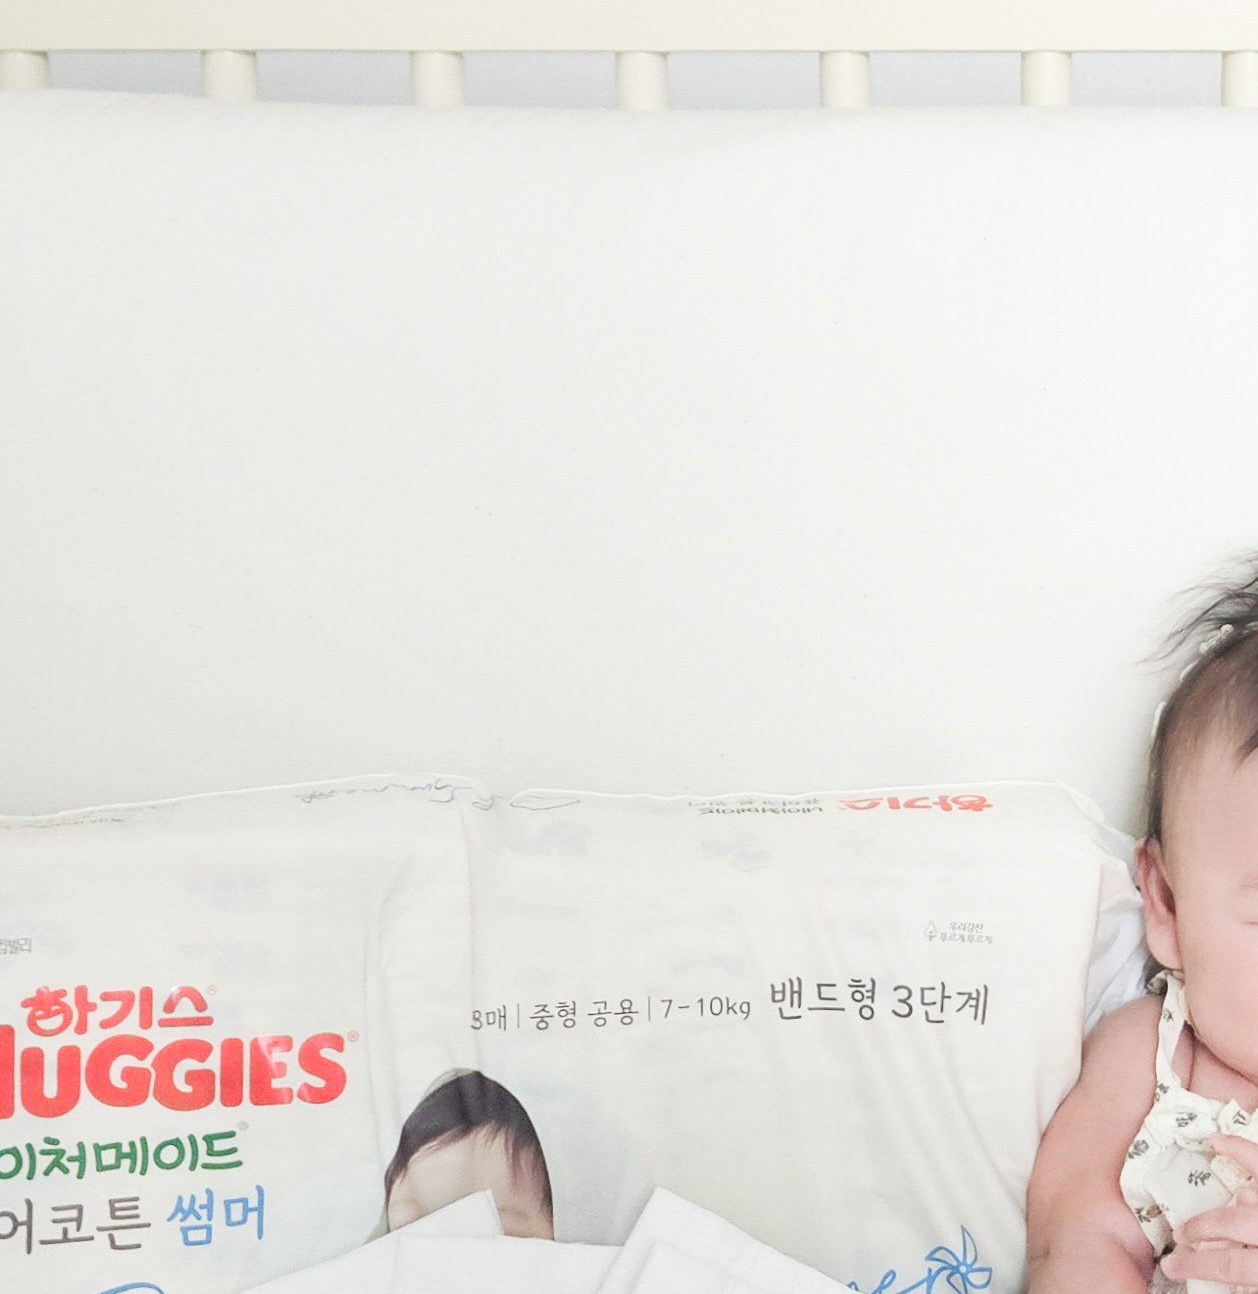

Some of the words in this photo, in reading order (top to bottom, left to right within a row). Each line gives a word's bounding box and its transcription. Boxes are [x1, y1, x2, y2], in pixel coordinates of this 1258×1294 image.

[21, 985, 214, 1037] 하기스
[529, 1000, 577, 1030] 중형
[587, 998, 639, 1027] 공용
[660, 996, 751, 1020] 7-10kg
[770, 976, 877, 1020] 밴드형
[891, 981, 989, 1025] 3단계
[166, 1185, 265, 1246] 썸머
